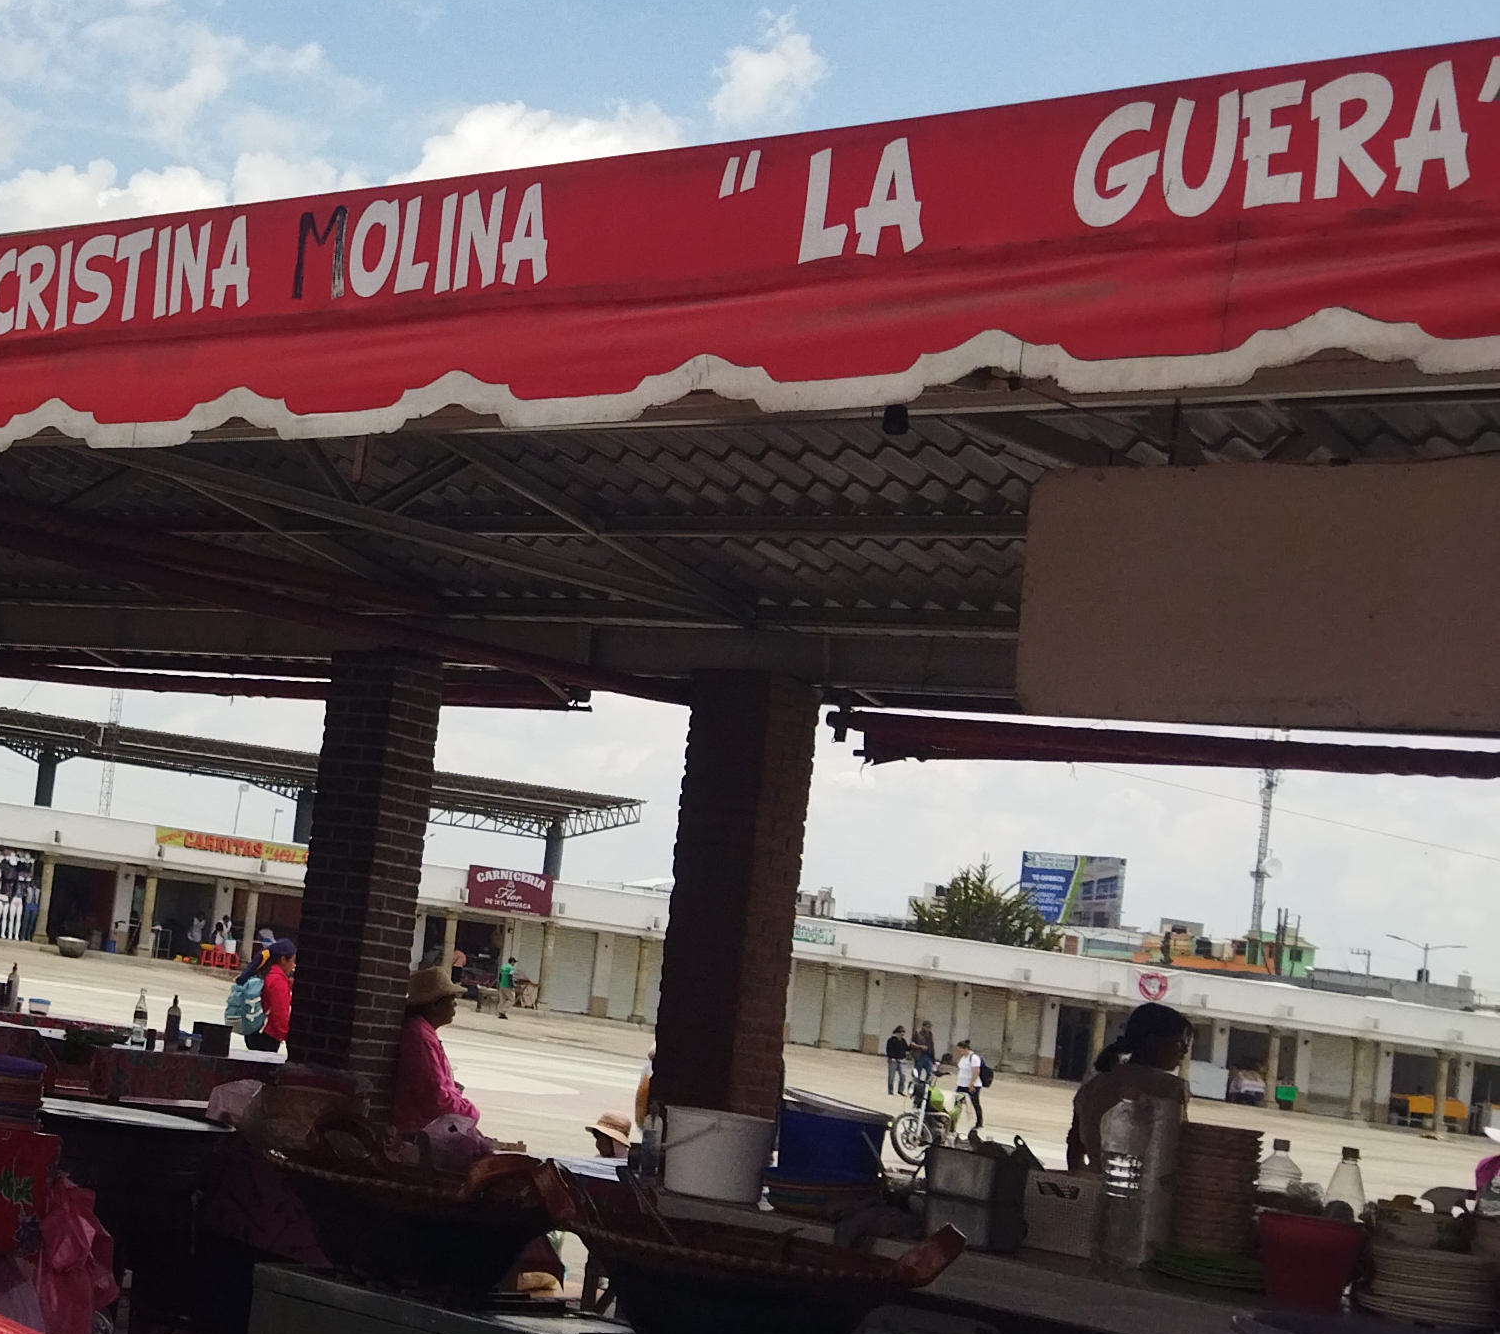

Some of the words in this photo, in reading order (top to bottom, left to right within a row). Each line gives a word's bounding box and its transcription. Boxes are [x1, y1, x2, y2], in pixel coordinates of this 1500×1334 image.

[291, 182, 549, 301] MOLINA
[184, 831, 263, 858] CARNITAS
[494, 886, 523, 902] Flor
